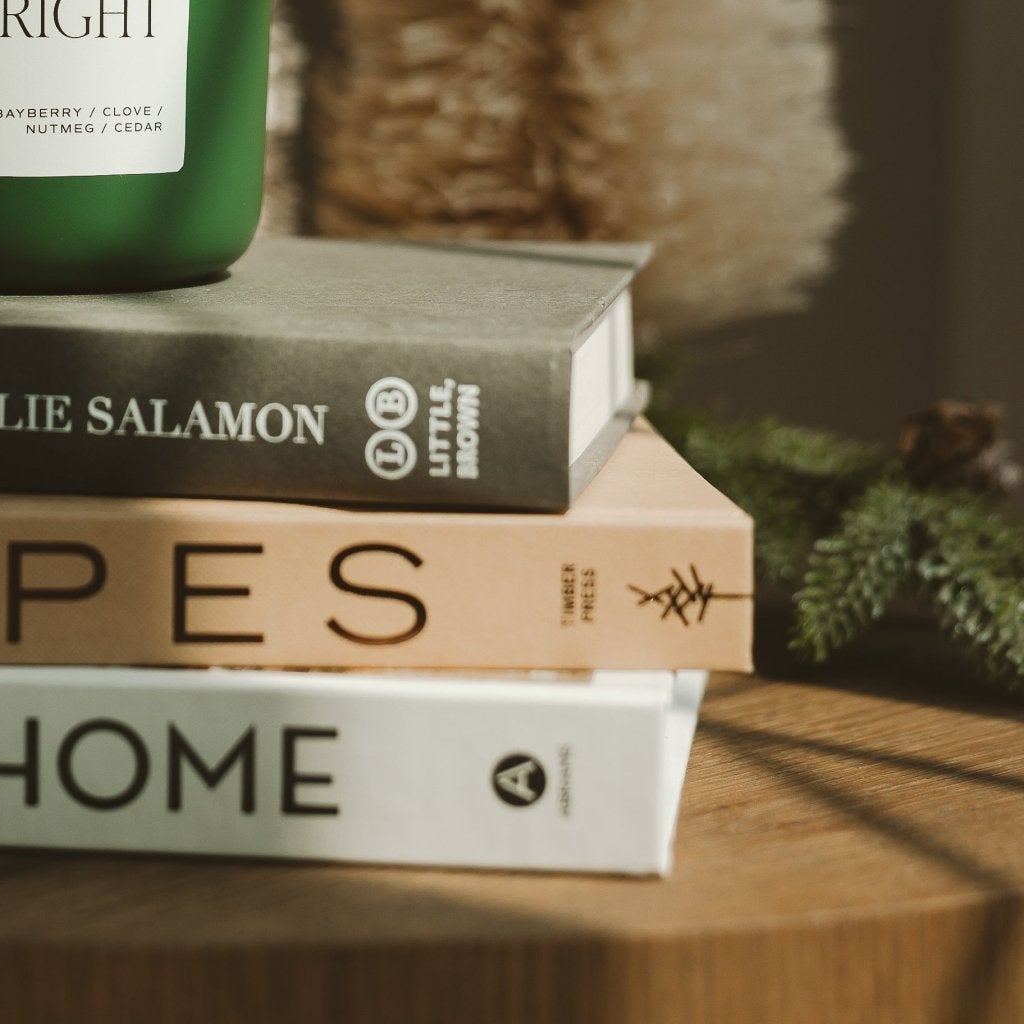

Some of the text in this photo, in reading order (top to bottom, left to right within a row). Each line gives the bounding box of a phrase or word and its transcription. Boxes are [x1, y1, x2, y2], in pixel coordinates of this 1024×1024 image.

[25, 123, 95, 135] NUTMEG
[114, 121, 163, 133] CEDAR
[102, 105, 151, 118] CLOVE
[87, 396, 329, 445] SALAMON
[429, 378, 456, 477] LITTLE,
[456, 384, 480, 479] BROWN
[561, 562, 575, 627] IMBER
[581, 567, 596, 624] PRESS
